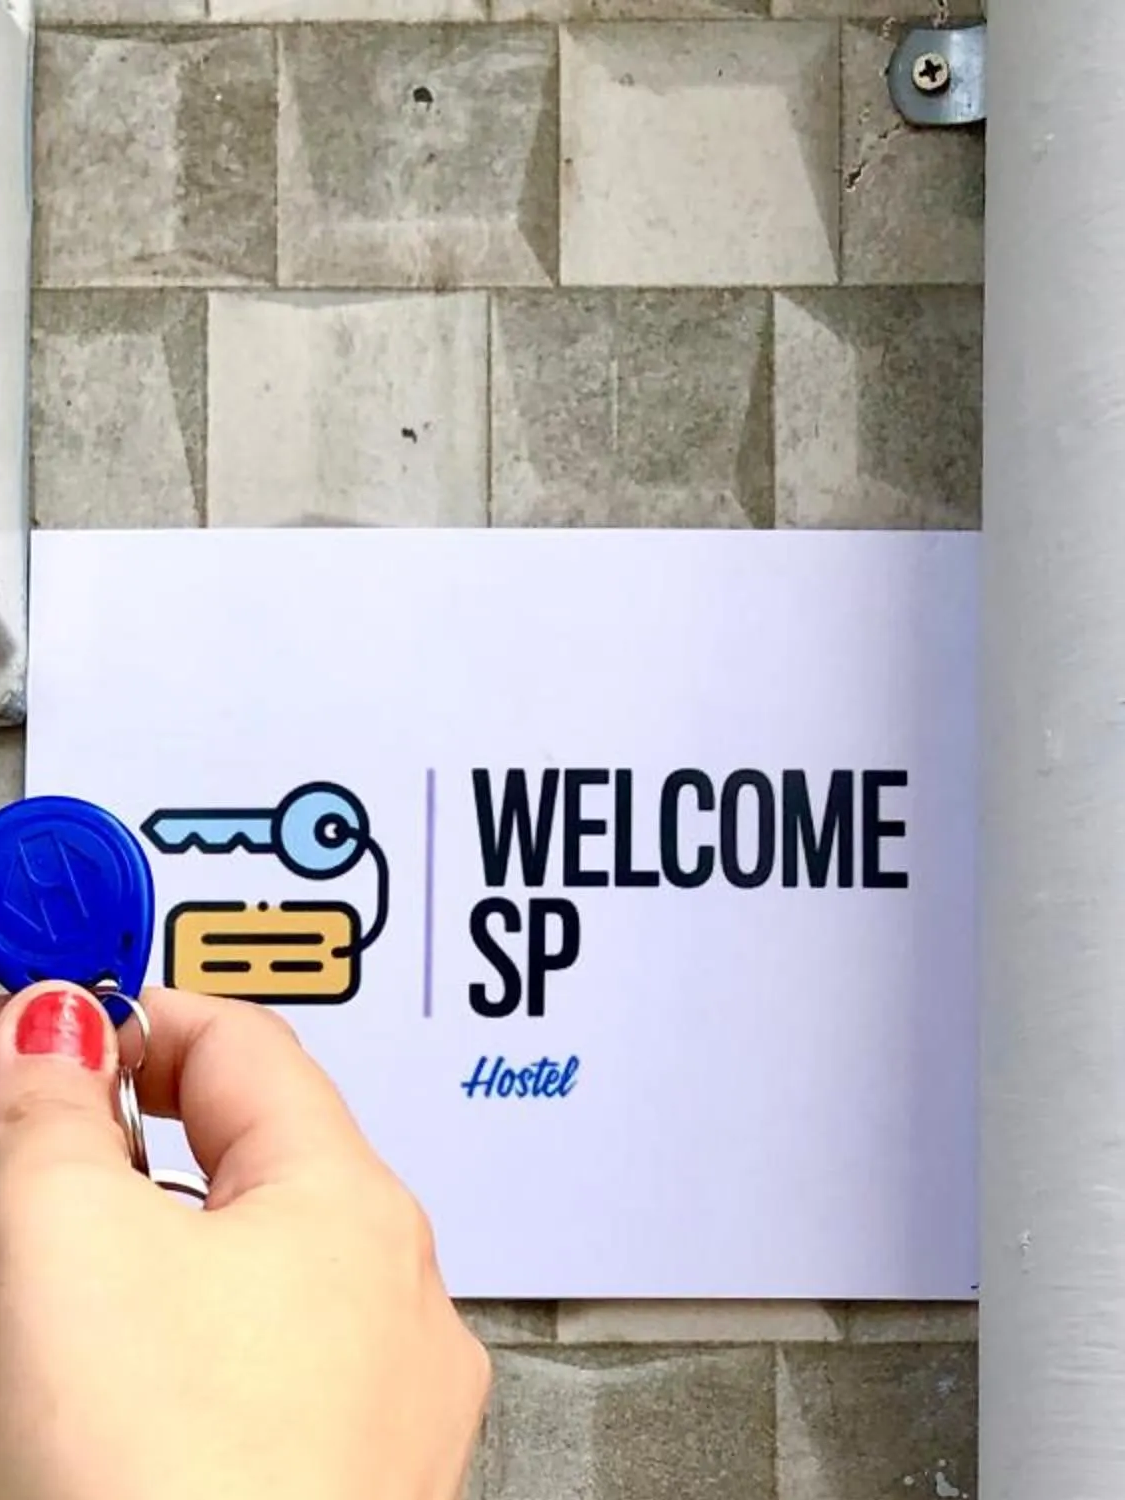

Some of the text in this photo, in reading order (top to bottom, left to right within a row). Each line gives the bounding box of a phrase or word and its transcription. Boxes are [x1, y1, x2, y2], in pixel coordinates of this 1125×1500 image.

[472, 768, 909, 889] WELCOME
[468, 897, 581, 1018] SP
[460, 1055, 581, 1099] Hostel
